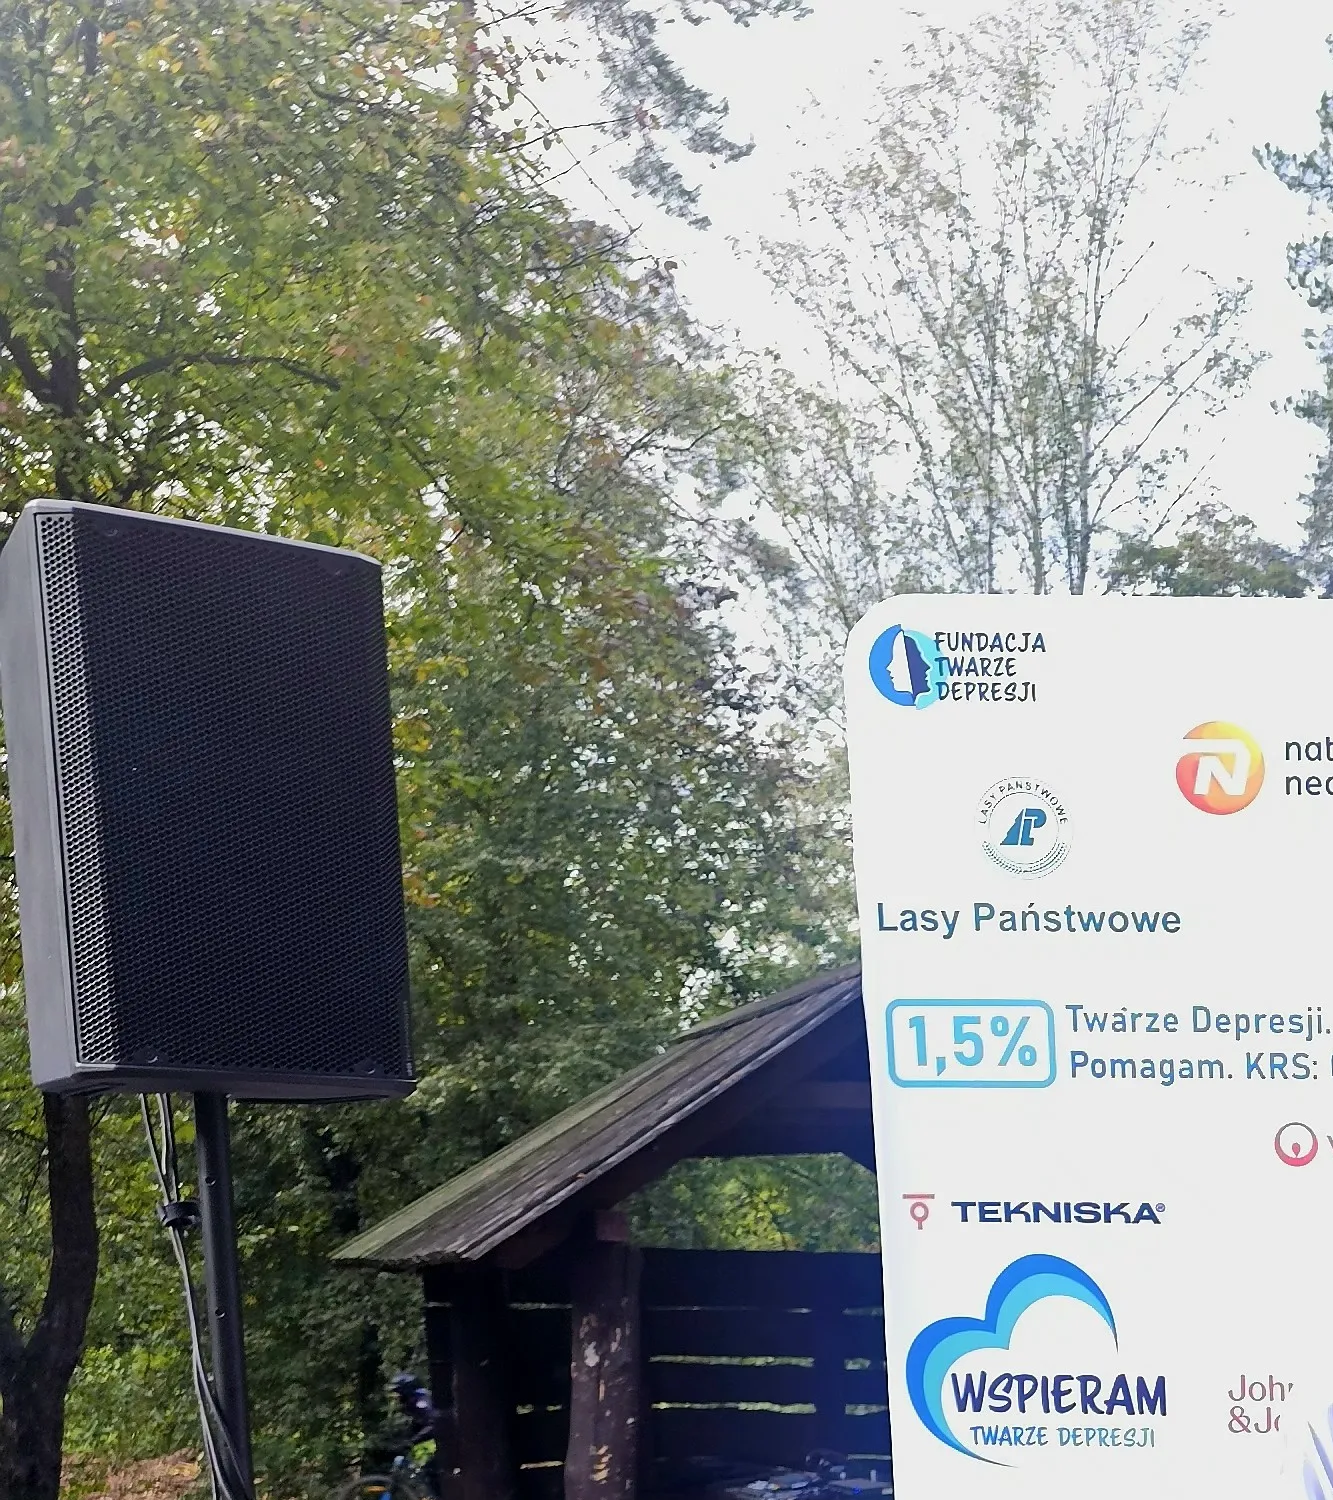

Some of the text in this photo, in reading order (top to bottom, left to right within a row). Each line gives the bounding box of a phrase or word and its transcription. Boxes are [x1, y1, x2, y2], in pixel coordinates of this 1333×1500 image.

[934, 631, 1047, 654] FUNDACJA
[935, 656, 1018, 678] TWARZE
[935, 680, 1038, 704] DEPRESJI
[877, 902, 1182, 939] Lasy Państwowe
[1065, 1004, 1180, 1034] Twarze
[1192, 1005, 1333, 1043] Depresji.
[907, 1014, 1038, 1077] 1,5%
[1070, 1051, 1234, 1087] Pomagam.
[1246, 1053, 1319, 1081] KRS:
[951, 1371, 1168, 1417] WSPIERAM
[970, 1425, 1156, 1448] TWARZE DEPRESJI
